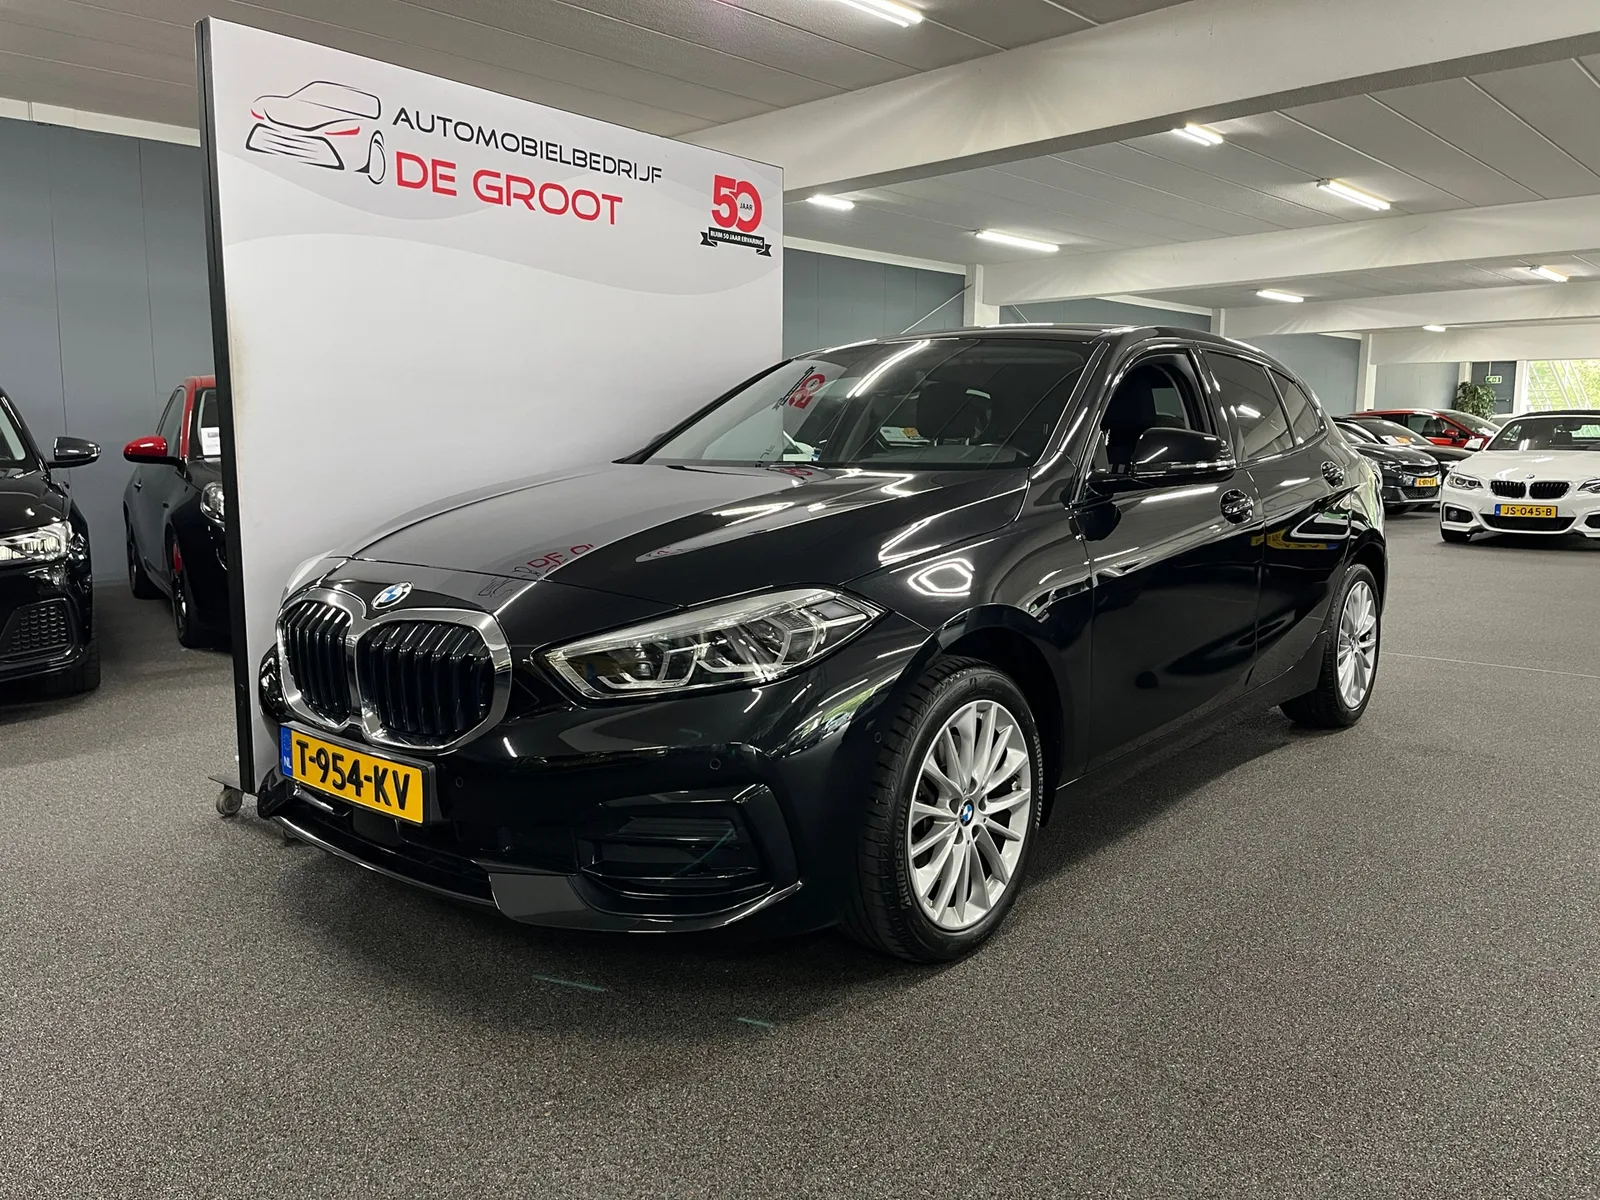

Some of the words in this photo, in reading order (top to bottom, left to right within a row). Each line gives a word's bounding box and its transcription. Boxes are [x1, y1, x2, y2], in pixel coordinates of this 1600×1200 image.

[393, 107, 662, 183] AUTOMOBIELBEDRIJF
[396, 151, 457, 196] DE
[472, 169, 623, 225] GROOT
[711, 174, 763, 233] 50
[739, 202, 753, 211] JAAR
[723, 232, 730, 240] 50
[1504, 506, 1552, 516] JS-045-B
[283, 755, 292, 769] NL
[296, 739, 410, 811] T-954-KV
